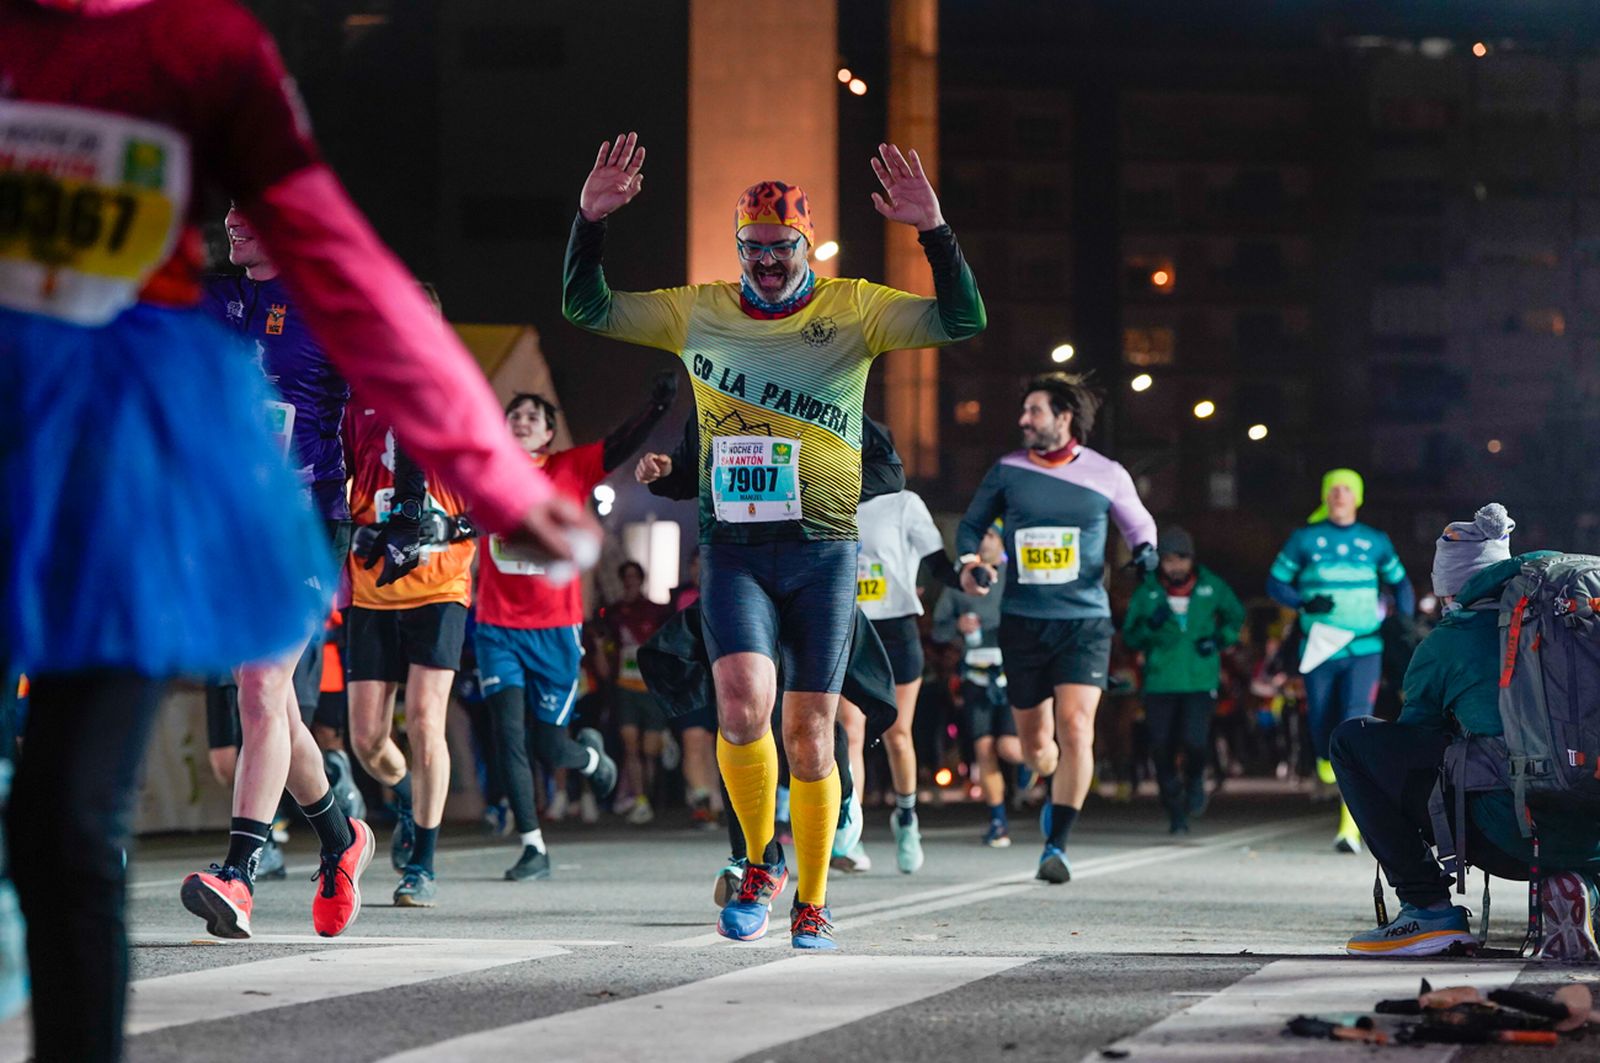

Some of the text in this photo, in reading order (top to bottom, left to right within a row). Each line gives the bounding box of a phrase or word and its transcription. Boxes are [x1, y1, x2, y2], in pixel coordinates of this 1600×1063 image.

[693, 354, 849, 437] CD LA PANDERA
[753, 445, 763, 454] DE
[728, 466, 778, 493] 7907
[1027, 547, 1070, 564] 13657
